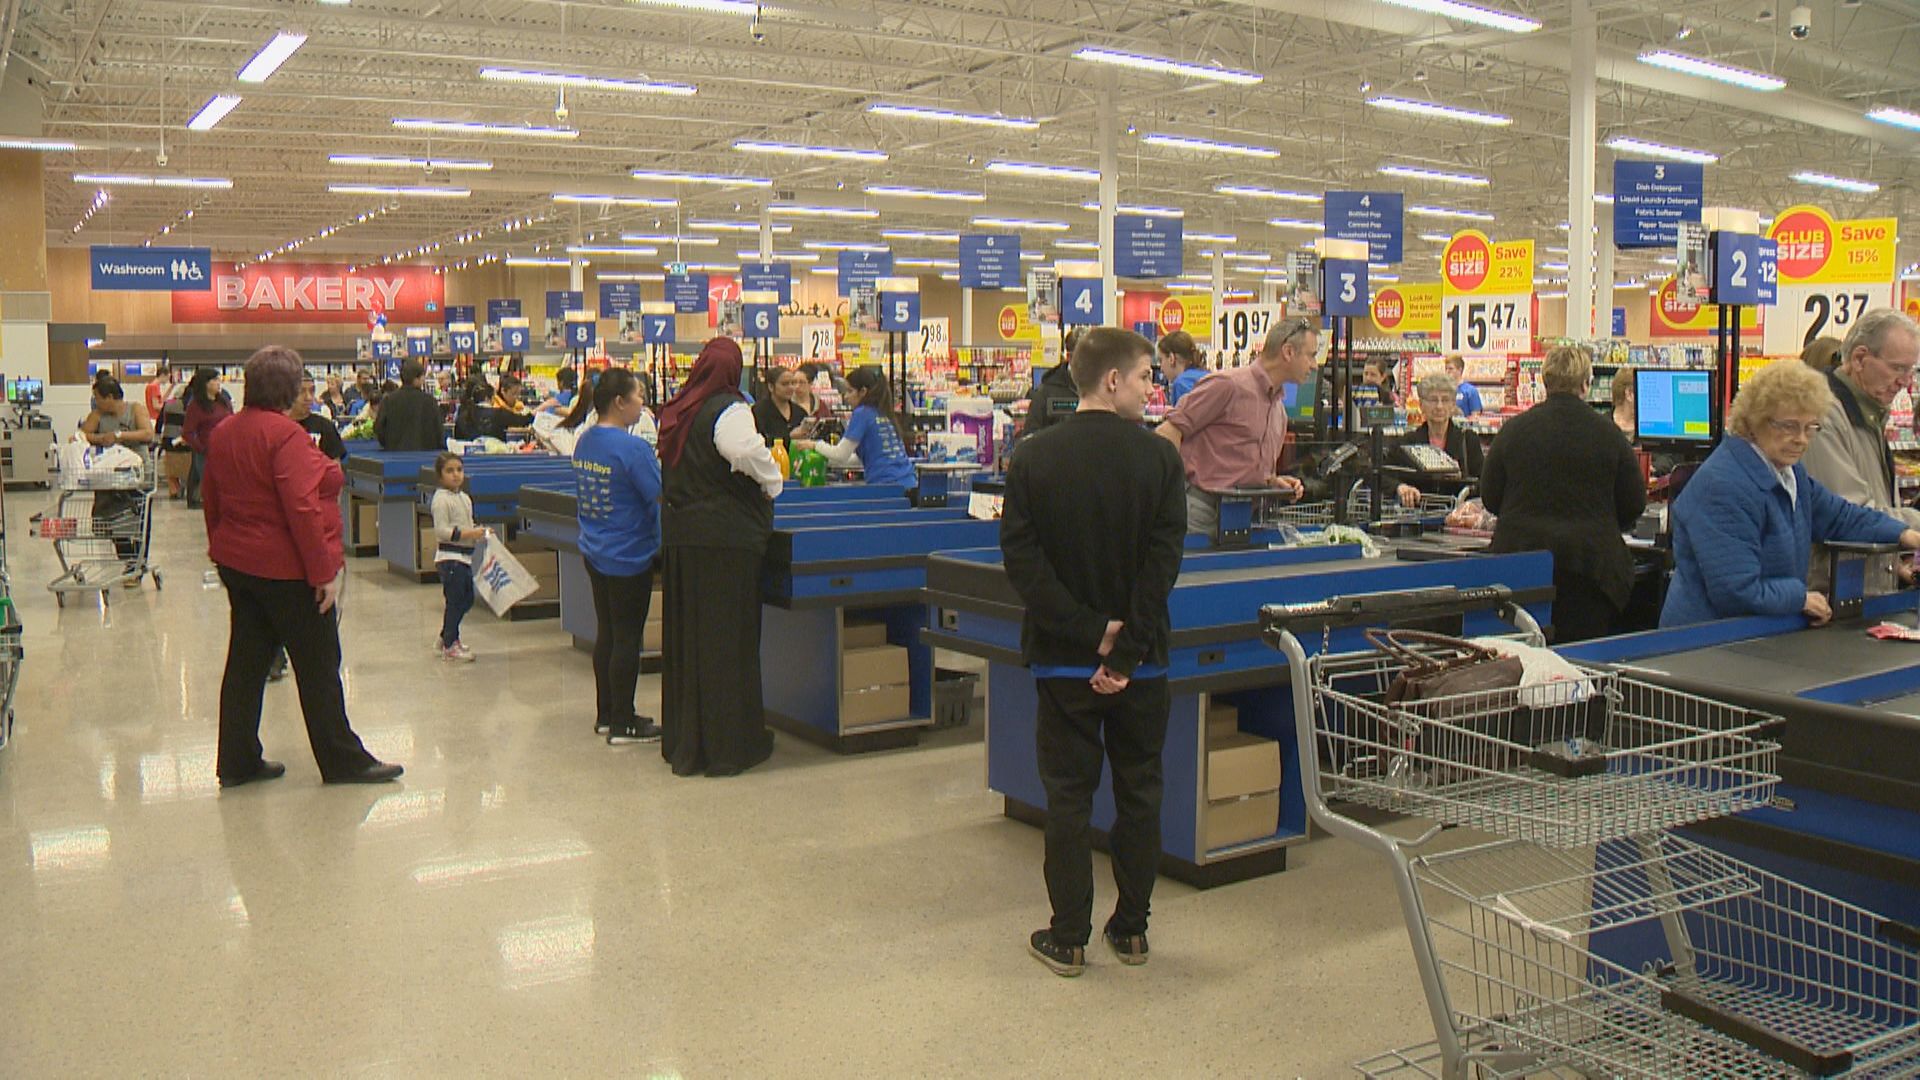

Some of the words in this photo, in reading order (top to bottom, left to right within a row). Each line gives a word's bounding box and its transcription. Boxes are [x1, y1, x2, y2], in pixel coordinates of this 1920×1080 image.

[1655, 164, 1665, 180] 3
[1635, 183, 1650, 191] Dish
[1651, 184, 1682, 192] Detergent
[1360, 195, 1370, 207] 4
[1620, 195, 1639, 204] Liquid
[1640, 196, 1666, 205] Laundry
[1667, 197, 1698, 206] Detergent
[1635, 208, 1655, 216] Fabric
[1145, 219, 1153, 229] 5
[1638, 221, 1657, 230] Paper
[1368, 231, 1392, 239] Cleaners
[1639, 233, 1658, 241] Facial
[1776, 229, 1825, 244] CLUB
[1841, 226, 1886, 241] Save
[986, 237, 994, 246] 6
[863, 253, 869, 261] 7
[1450, 250, 1485, 262] CLUB
[1495, 247, 1527, 260] Save
[1776, 243, 1825, 260] SIZE
[1847, 249, 1879, 264] 15%
[99, 262, 165, 276] Washroom
[1449, 261, 1485, 276] SIZE
[1499, 266, 1523, 279] 22%
[1731, 250, 1747, 287] 2
[216, 276, 405, 311] BAKERY
[1340, 273, 1356, 303] 3
[1074, 288, 1093, 314] 4
[1377, 299, 1401, 309] CLUB
[1664, 301, 1697, 312] SIZE
[894, 301, 909, 323] 5
[1377, 308, 1401, 319] SIZE
[755, 311, 770, 330] 6
[1164, 316, 1182, 325] SIZE
[1446, 303, 1487, 351] 15
[1491, 303, 1516, 330] 47
[1802, 292, 1831, 349] 2
[1834, 293, 1870, 325] 37
[576, 326, 588, 342] 8
[654, 320, 667, 337] 7
[1218, 311, 1249, 351] 19
[1251, 311, 1270, 334] 97
[454, 336, 472, 349] 10
[511, 331, 523, 347] 9
[1491, 339, 1510, 350] LIMIT
[377, 343, 391, 355] 12
[414, 340, 427, 353] 11
